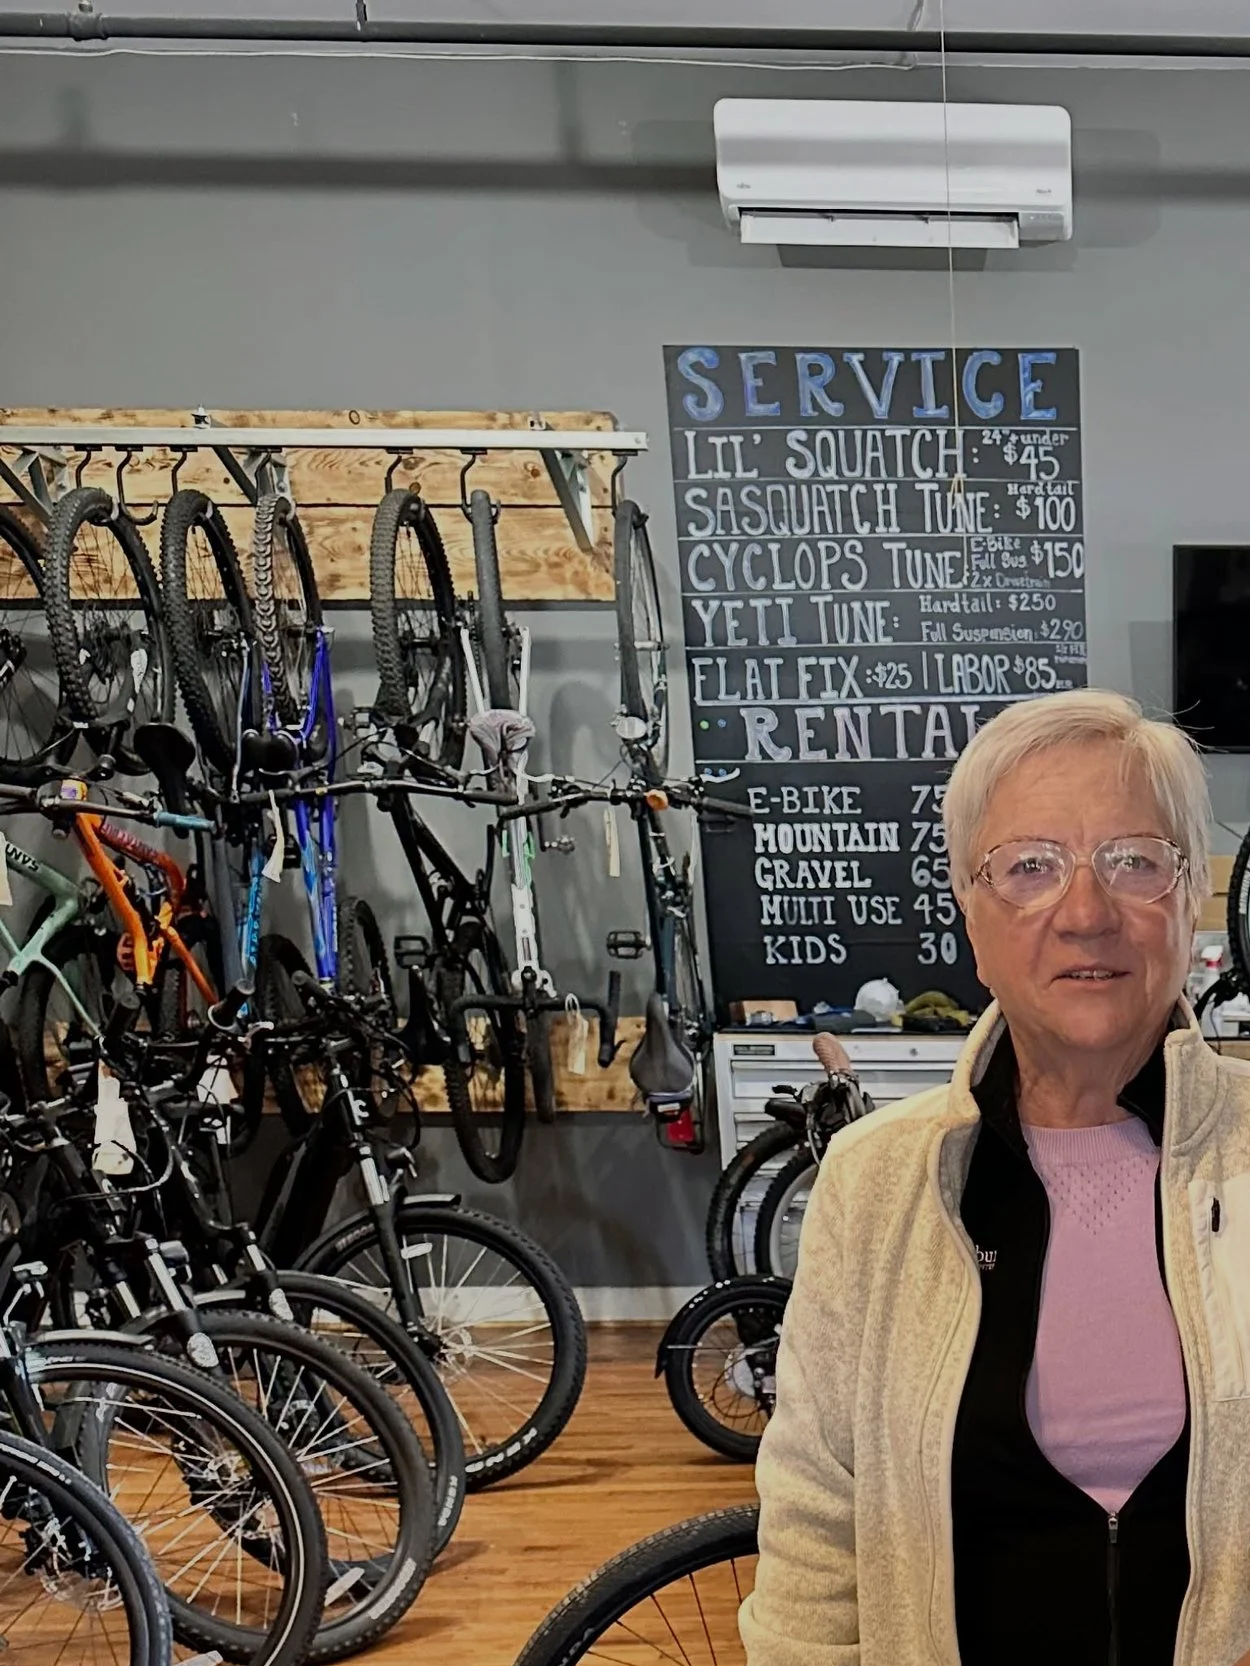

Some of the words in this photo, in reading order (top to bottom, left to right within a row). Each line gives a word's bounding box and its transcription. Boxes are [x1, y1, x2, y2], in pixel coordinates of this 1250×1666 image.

[677, 347, 1057, 421] SERVICE
[1002, 441, 1060, 481] $45
[685, 482, 901, 536] SASQUATCH
[1015, 496, 1076, 532] $100
[688, 541, 868, 591] CYCLOPS
[1030, 539, 1085, 579] $150
[691, 597, 797, 647] YETI
[1008, 594, 1057, 612] $250
[1039, 618, 1084, 641] $290
[691, 657, 784, 702] FLAT
[797, 655, 864, 699] FIX
[934, 652, 1012, 694] LABOR
[1012, 654, 1058, 690] $85
[748, 786, 863, 814] E-BIKE
[753, 822, 900, 853] MOUNTAIN
[754, 856, 872, 889] GRAVEL
[910, 855, 952, 889] 65
[760, 895, 837, 925] MULTI
[849, 897, 902, 925] USE
[912, 894, 957, 925] 45
[764, 934, 847, 965] KIDS
[916, 933, 959, 965] 30
